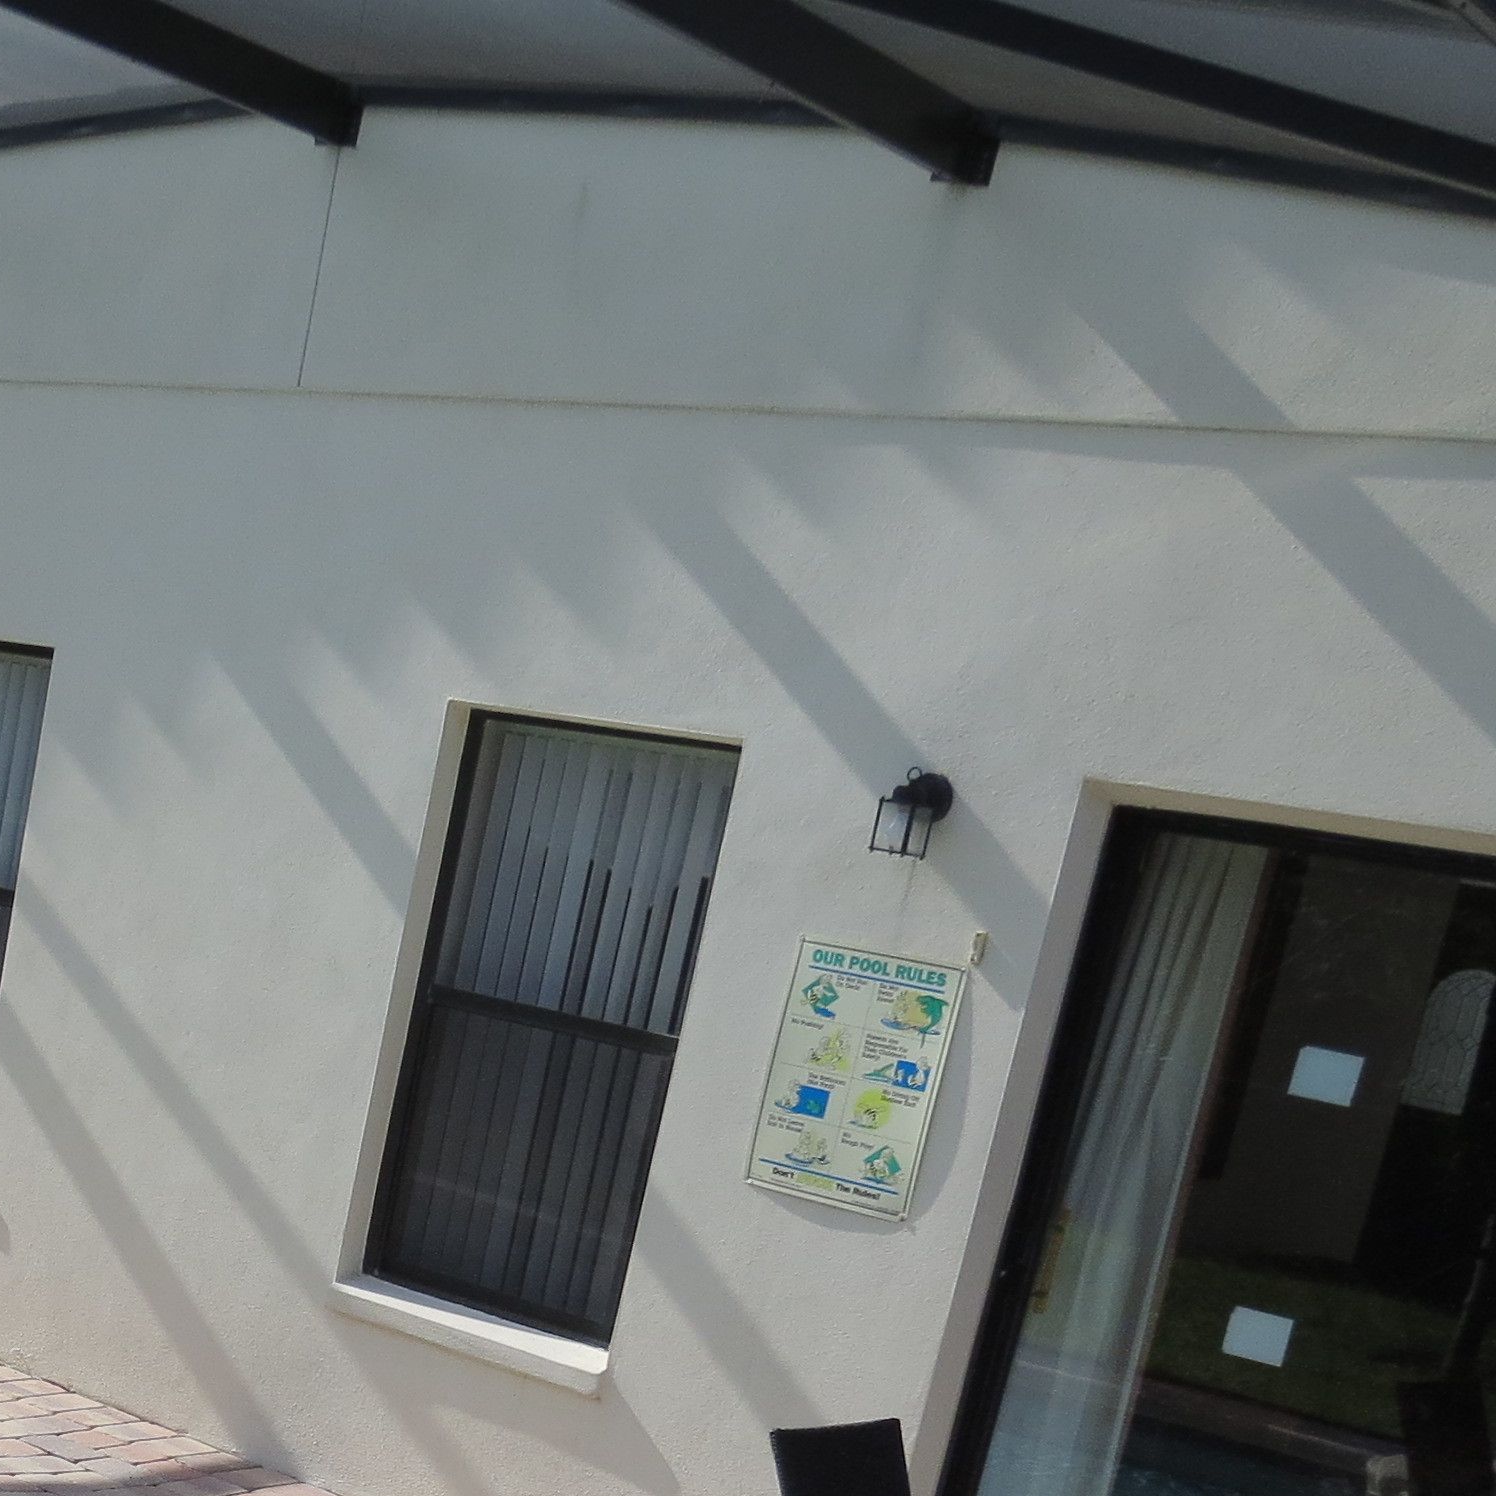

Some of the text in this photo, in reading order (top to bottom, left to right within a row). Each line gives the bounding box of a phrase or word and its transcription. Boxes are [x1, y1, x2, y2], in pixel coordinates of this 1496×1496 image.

[812, 949, 947, 987] OUR POOL RULES
